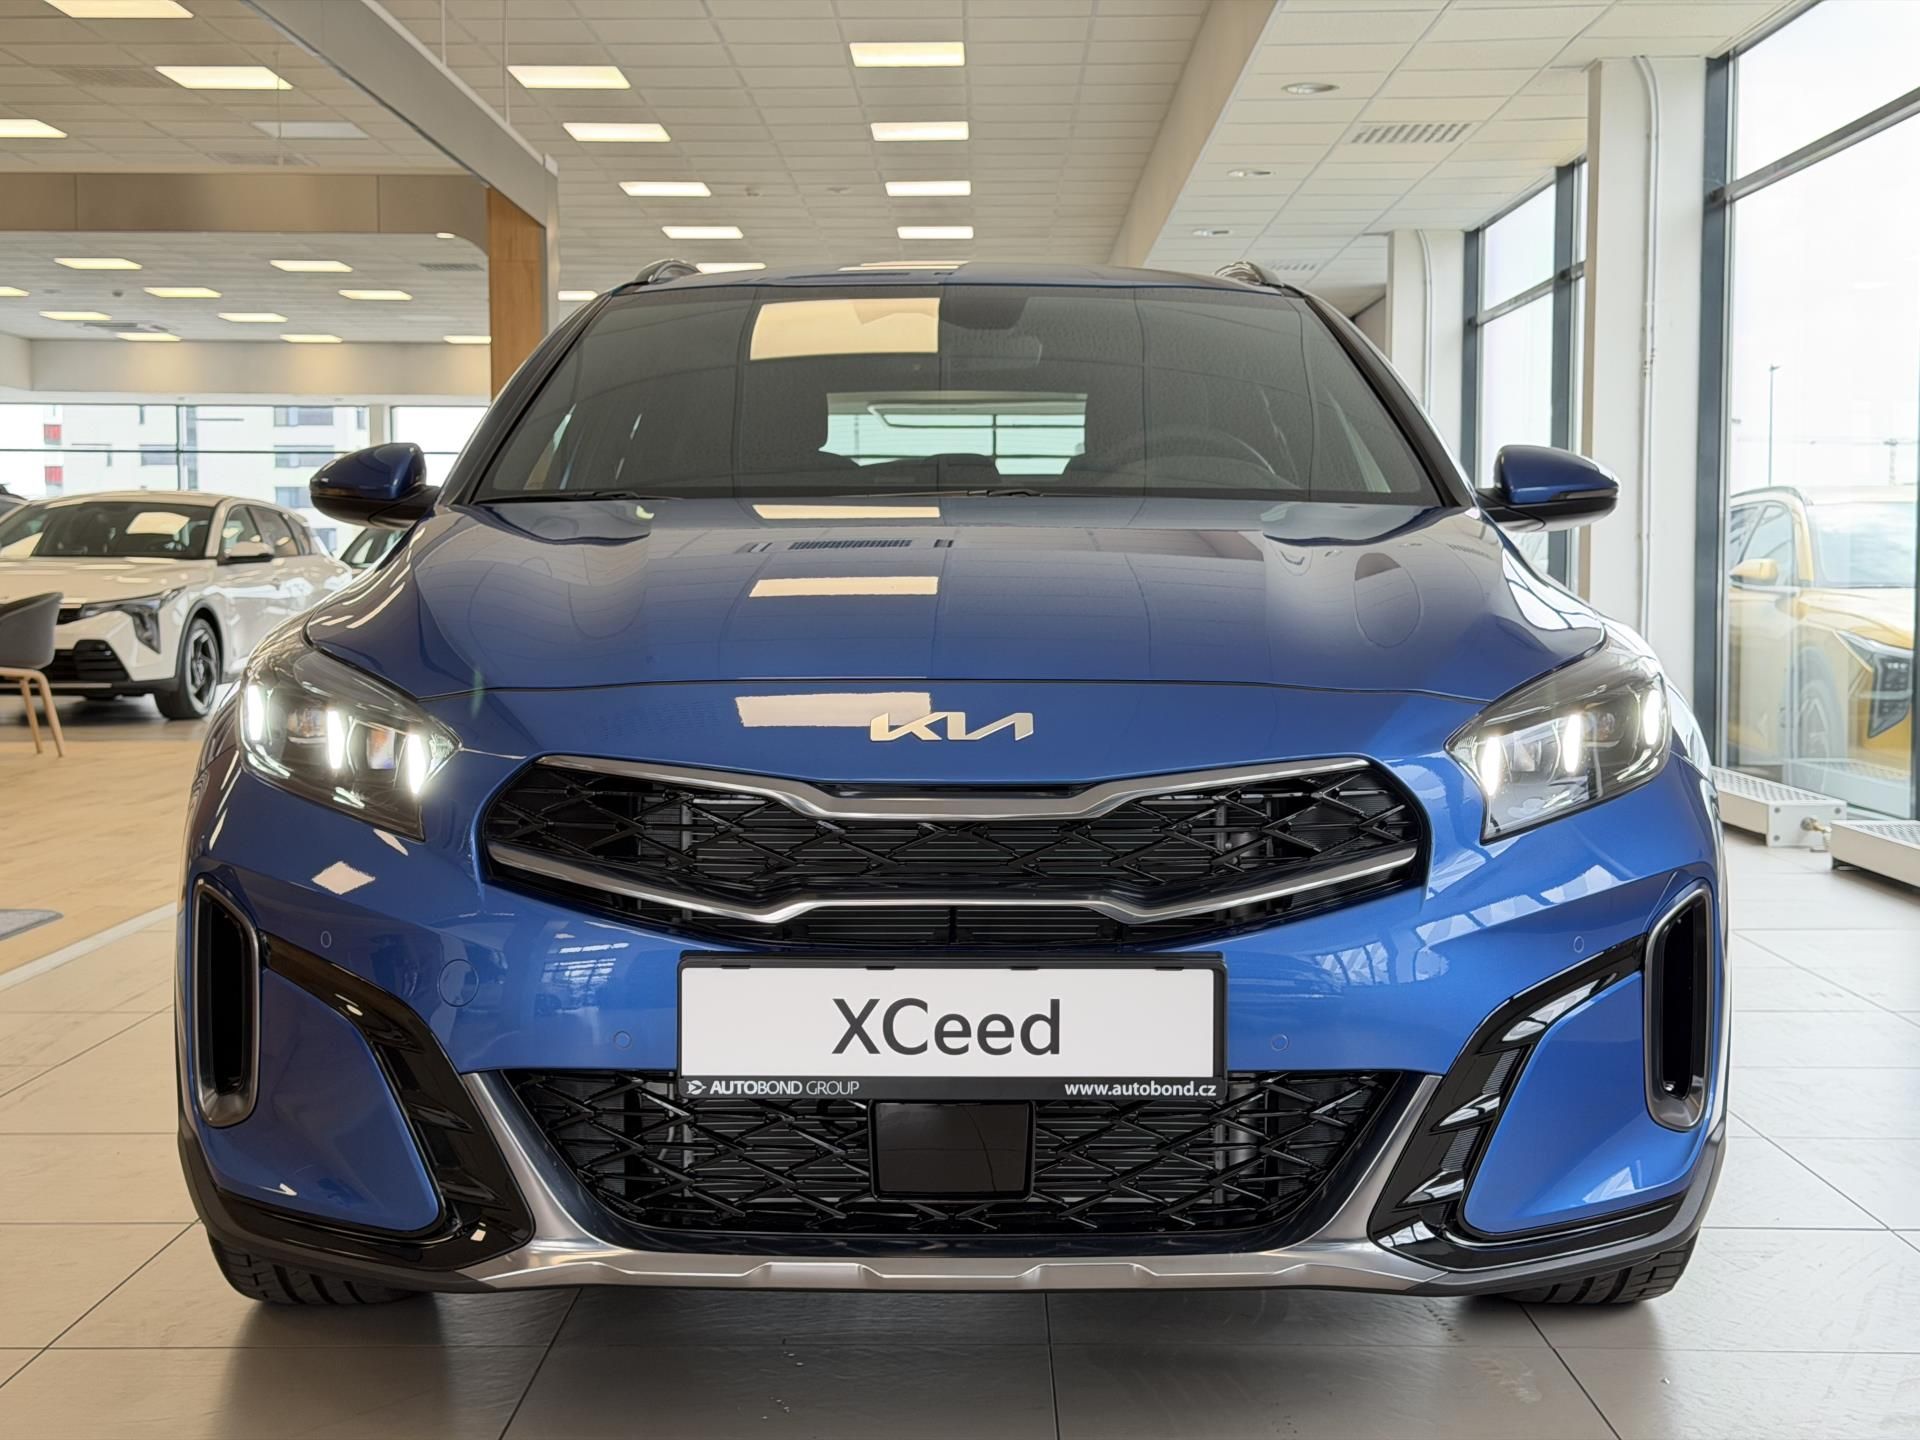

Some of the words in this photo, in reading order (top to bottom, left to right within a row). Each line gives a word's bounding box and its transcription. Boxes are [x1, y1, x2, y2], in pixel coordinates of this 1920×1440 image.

[870, 711, 1034, 741] KIA
[832, 998, 1060, 1056] XCeed
[709, 1080, 803, 1095] AUTOBOND
[806, 1080, 860, 1095] GROUP
[1064, 1080, 1217, 1096] www.autobond.cz
